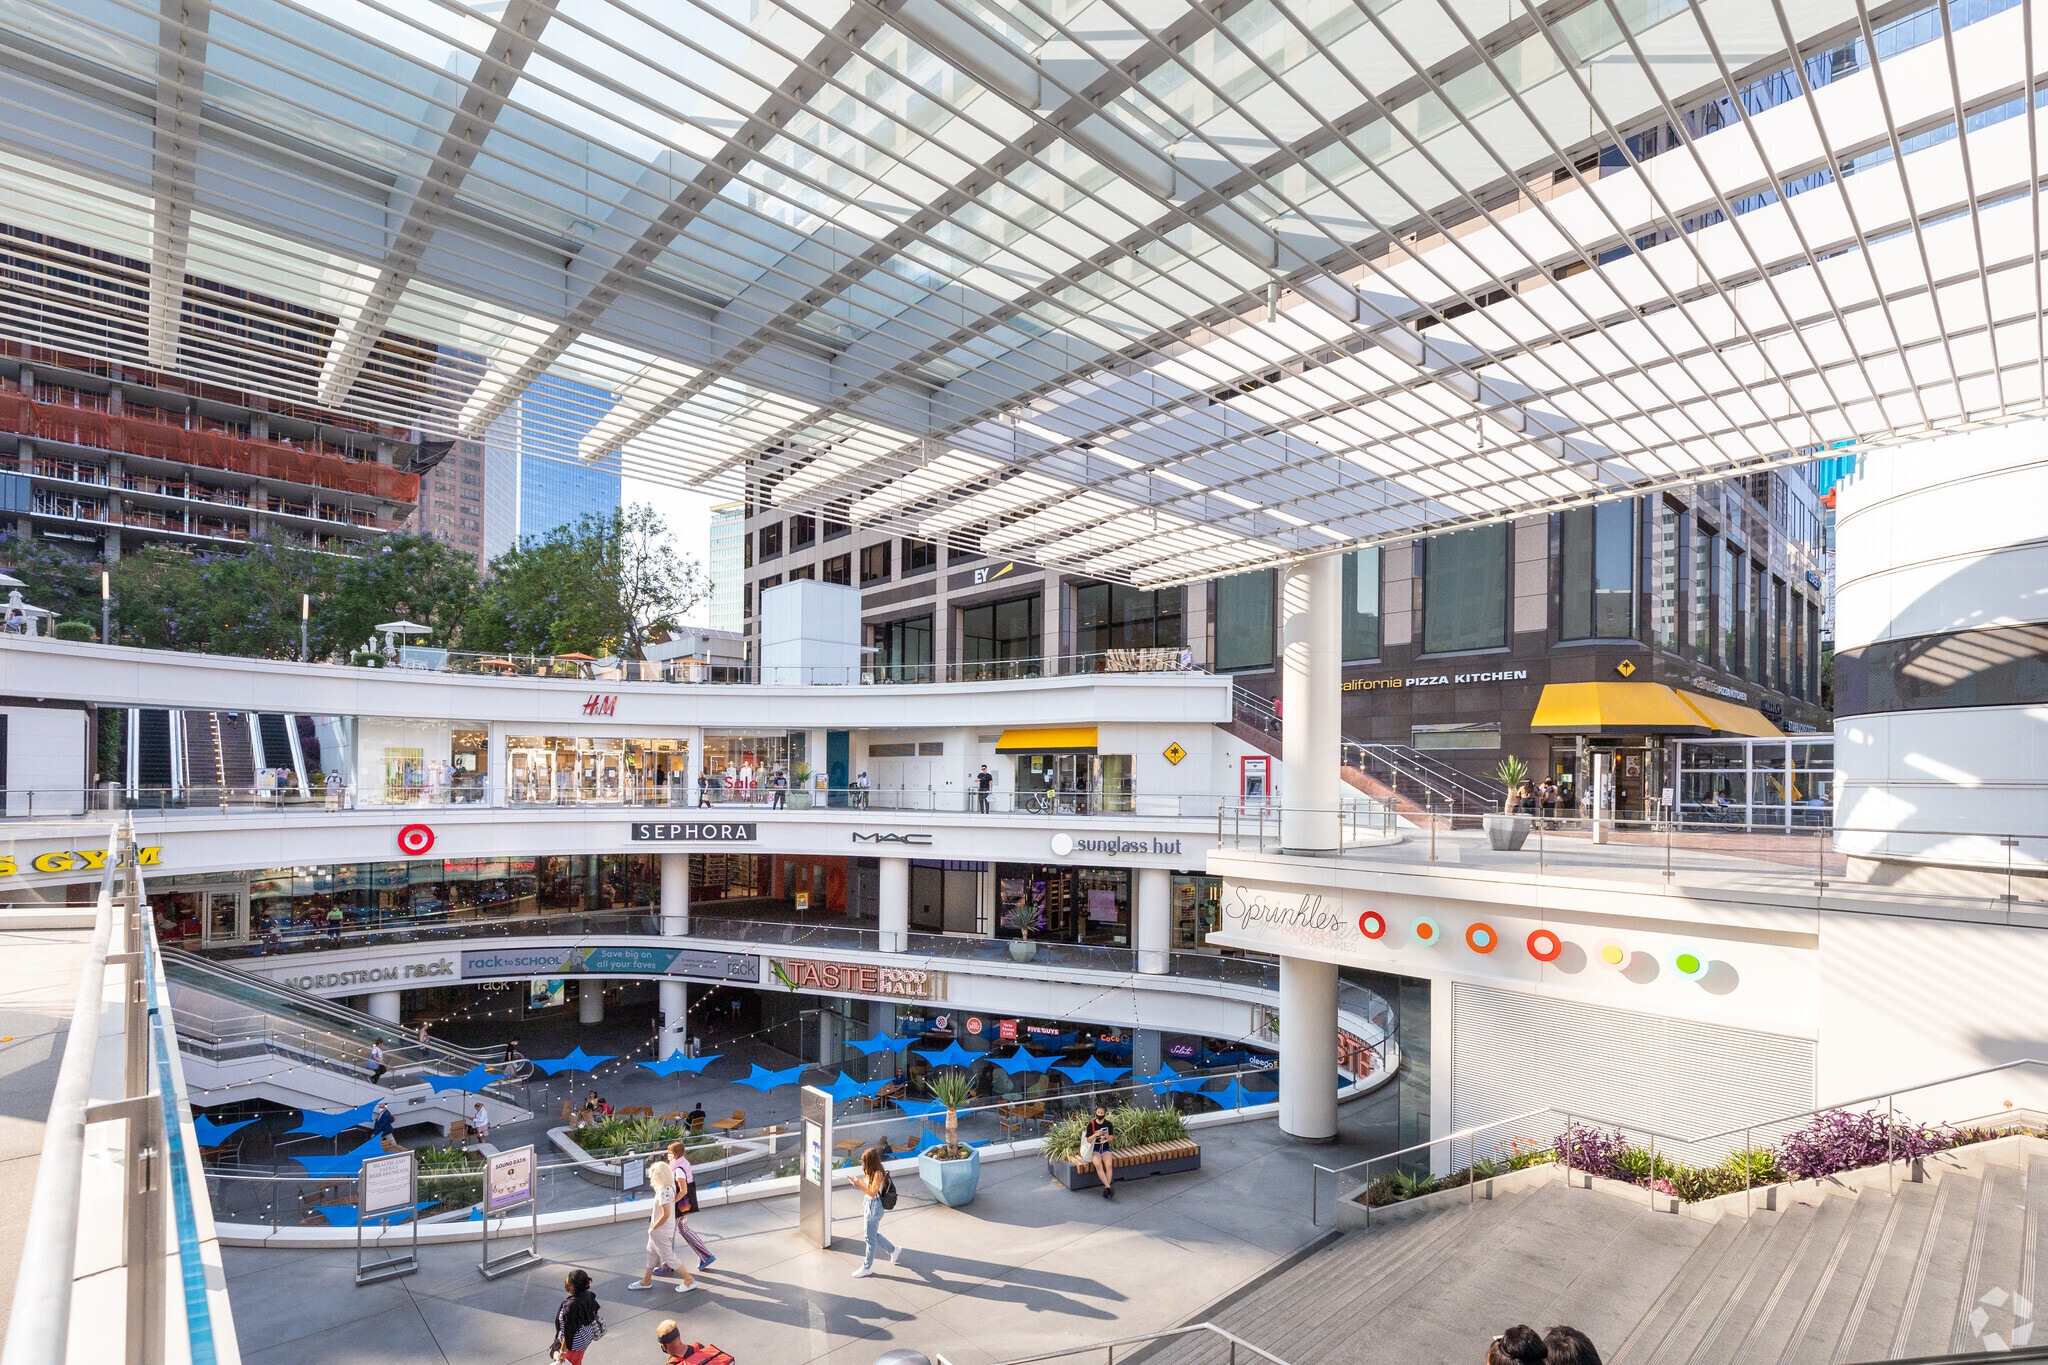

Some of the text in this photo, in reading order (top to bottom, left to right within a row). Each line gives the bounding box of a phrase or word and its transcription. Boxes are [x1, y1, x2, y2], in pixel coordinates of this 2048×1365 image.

[974, 568, 989, 584] EY
[1341, 670, 1527, 691] alifornia PIZZA KITCHEN
[583, 694, 618, 717] H&M
[724, 776, 758, 789] Sale
[640, 824, 748, 839] SEPHORA
[1078, 836, 1182, 857] sunglass hut
[1225, 885, 1348, 932] Sprinkles
[468, 956, 502, 969] rack
[515, 956, 562, 967] SCHOOL
[601, 949, 623, 959] Save
[625, 949, 640, 961] big
[597, 960, 657, 971] all your faves
[727, 960, 756, 976] rack
[285, 957, 454, 991] NORDSTROM rack
[788, 961, 877, 992] TASTE
[880, 968, 927, 984] FOOD
[880, 981, 927, 997] HALL
[495, 1157, 526, 1170] SOUND BATH
